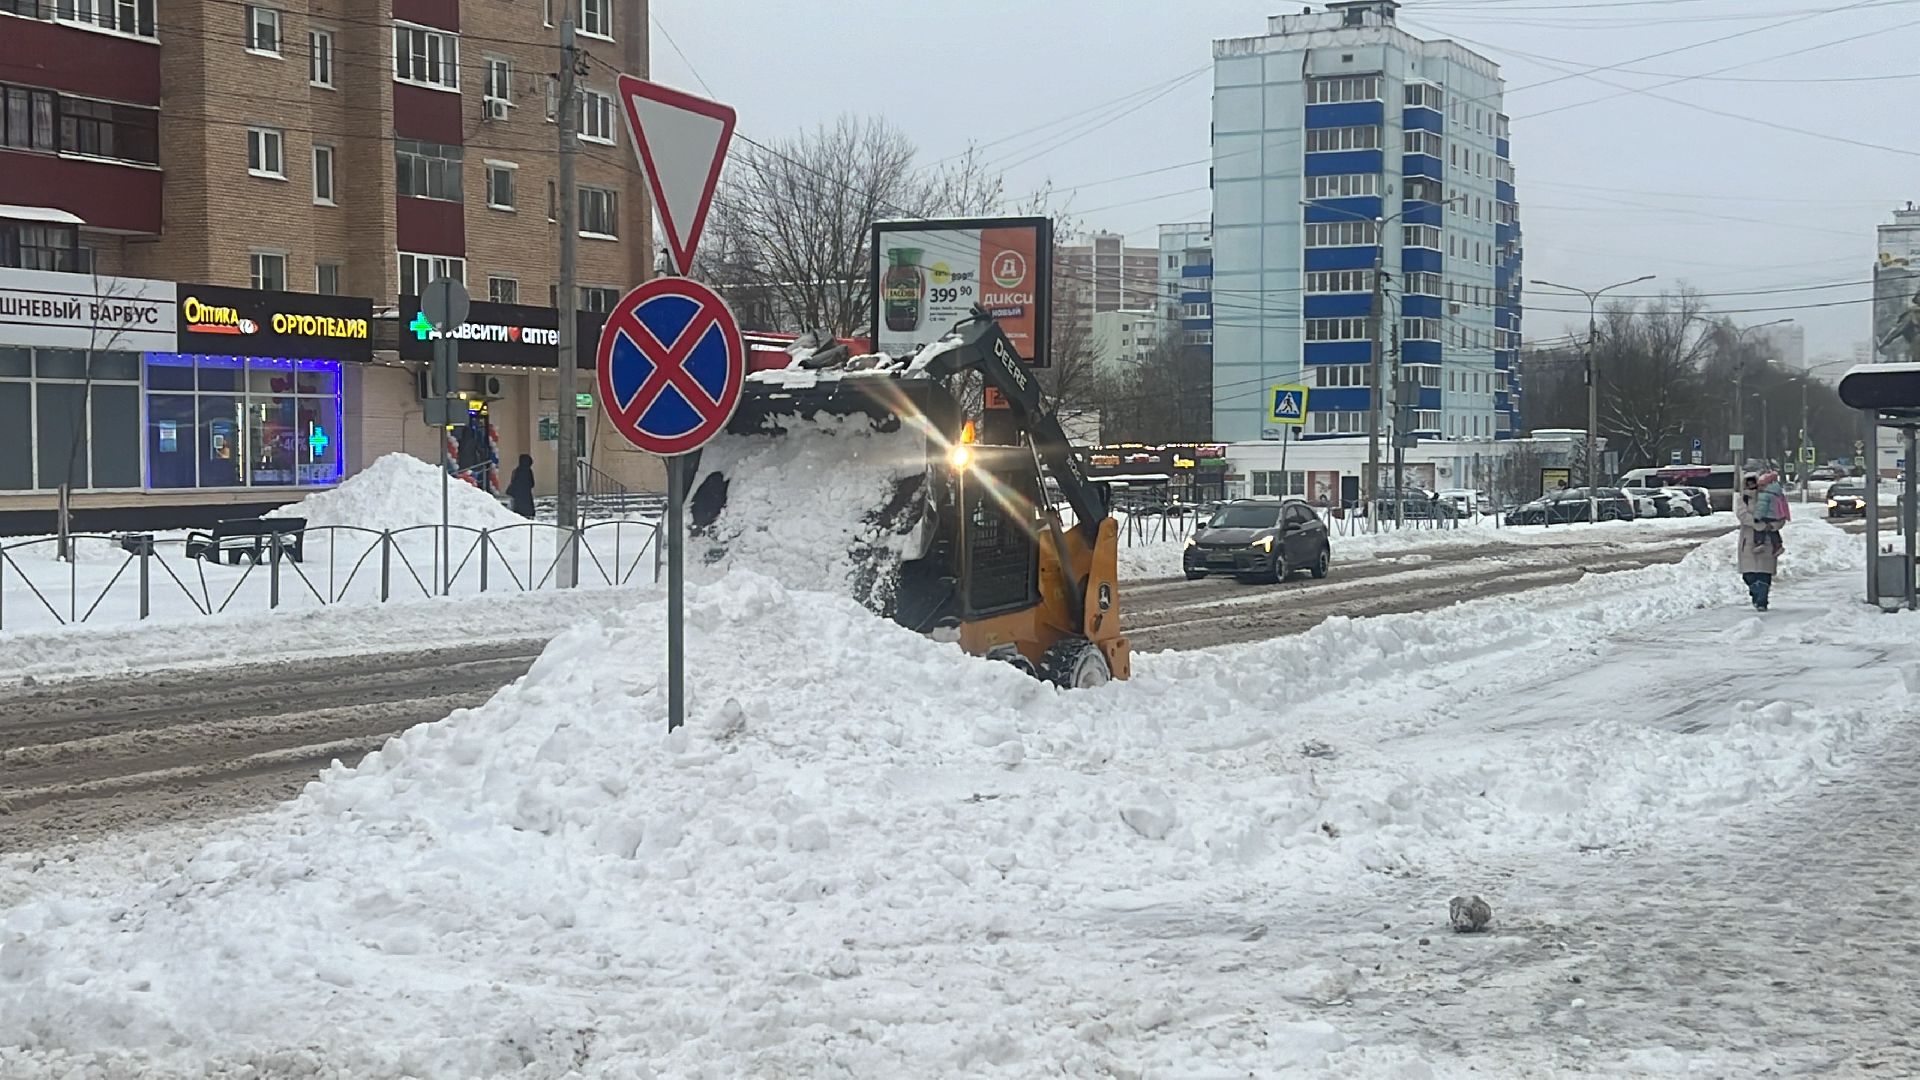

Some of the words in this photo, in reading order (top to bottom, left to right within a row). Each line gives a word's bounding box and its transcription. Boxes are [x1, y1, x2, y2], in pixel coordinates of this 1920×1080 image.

[929, 288, 957, 303] 399
[960, 286, 973, 296] 90
[0, 296, 81, 319] ШНЕВЫЙ
[271, 313, 368, 339] ОРТОПЕДИЯ
[994, 337, 1027, 391] DEERE
